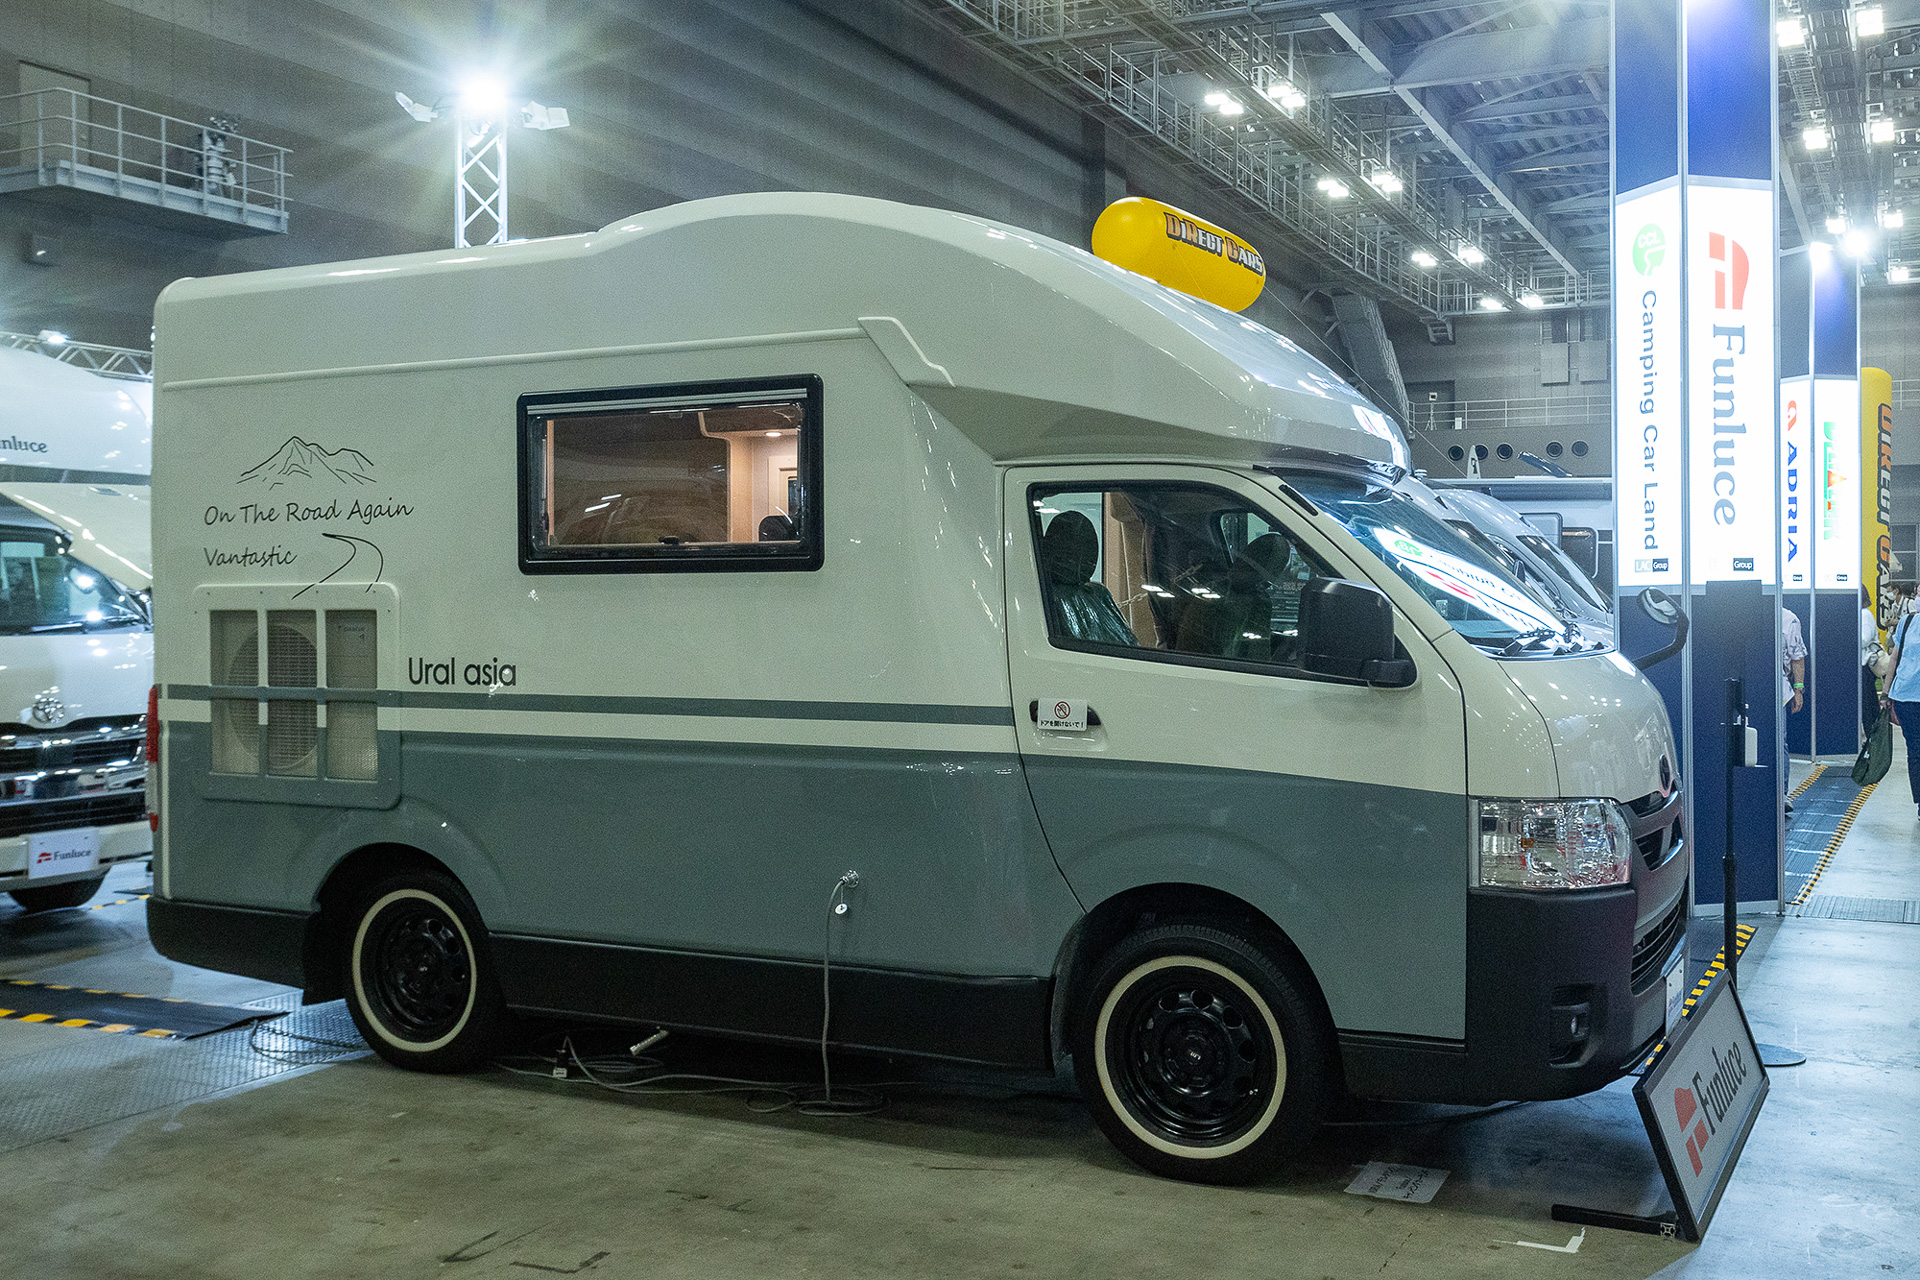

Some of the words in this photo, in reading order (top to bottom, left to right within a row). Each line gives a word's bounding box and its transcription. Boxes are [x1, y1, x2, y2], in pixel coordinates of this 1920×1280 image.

[1637, 230, 1661, 249] CCL
[1225, 236, 1263, 276] CARS
[1639, 290, 1658, 414] Camping
[1712, 323, 1747, 526] Funluce
[0, 435, 48, 453] nluce
[1643, 424, 1659, 472] Car
[204, 505, 236, 525] On
[239, 503, 280, 524] The
[286, 499, 342, 522] Road
[346, 496, 414, 525] Again
[1643, 482, 1659, 550] Land
[1787, 441, 1798, 563] ADRIA
[203, 544, 298, 567] Vantastic
[1653, 560, 1668, 571] Group
[1733, 560, 1754, 571] Group
[408, 657, 456, 685] Ural
[463, 657, 516, 686] asia
[53, 849, 92, 861] Funluce
[1692, 1041, 1747, 1136] Funluce
